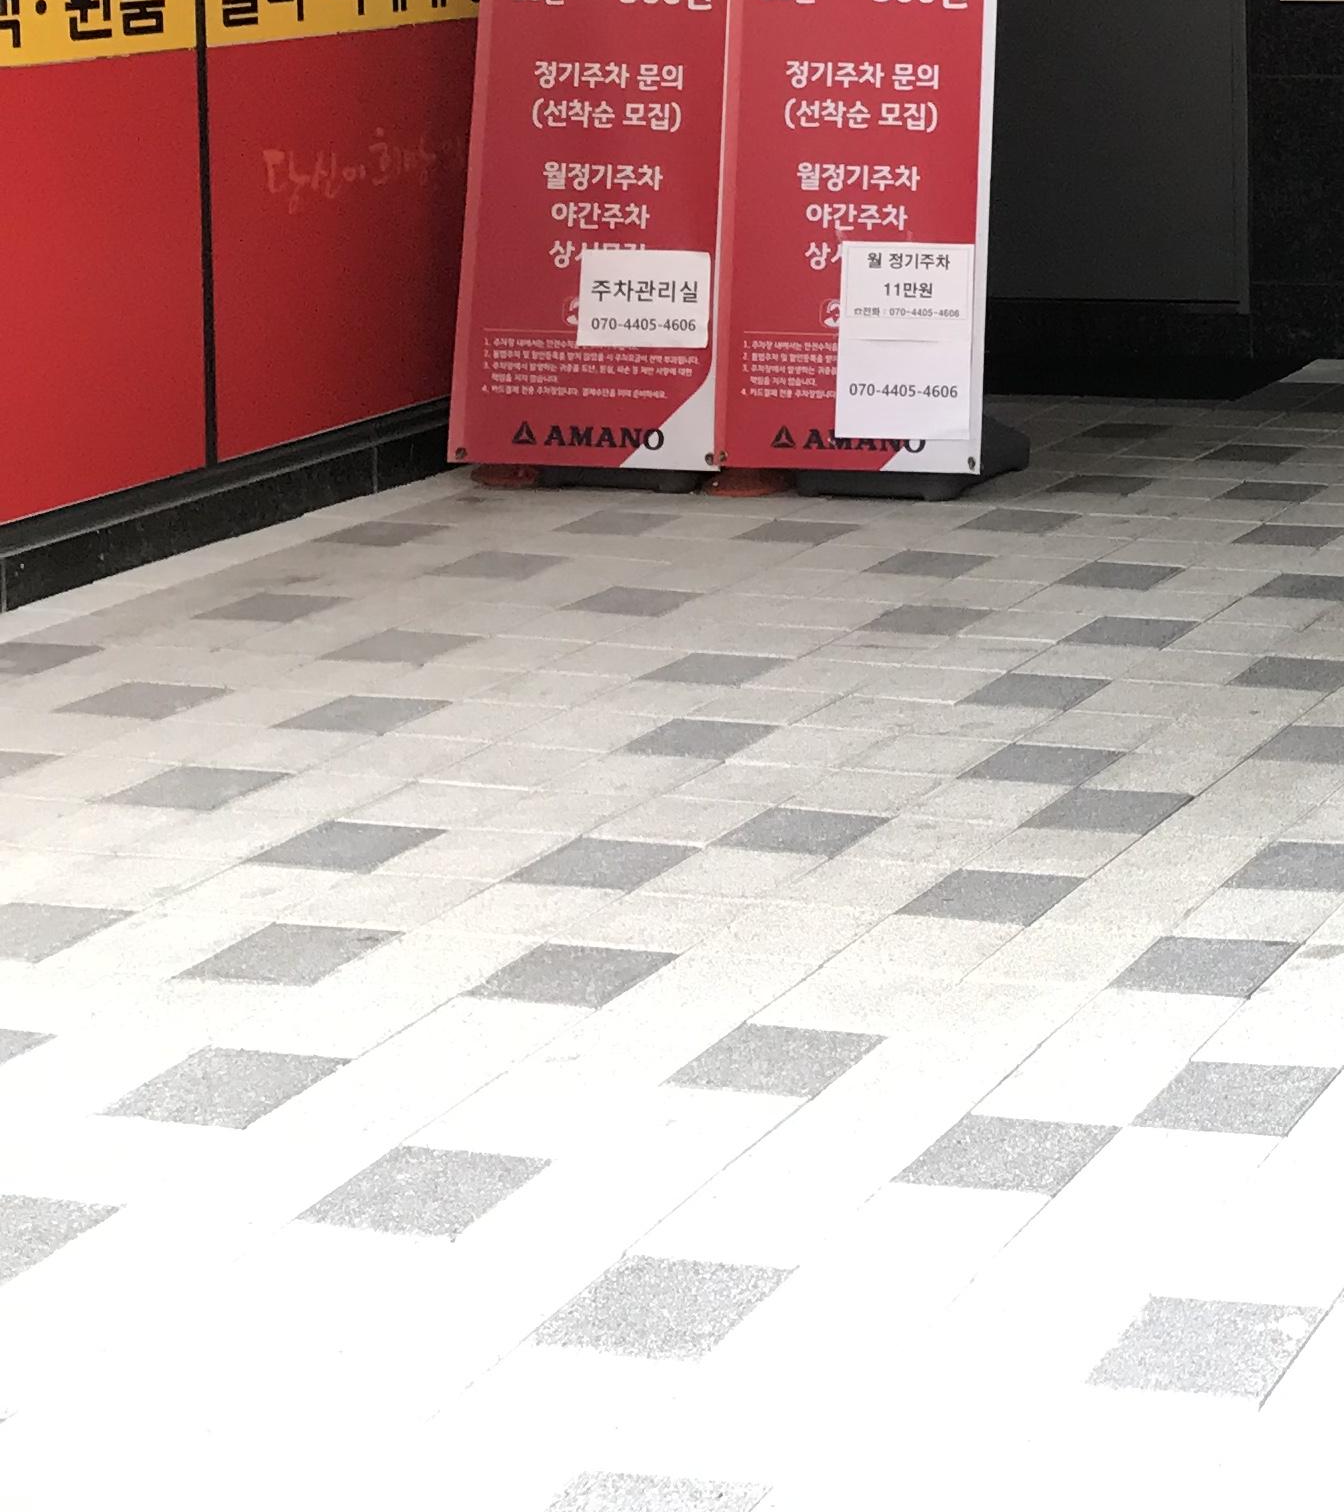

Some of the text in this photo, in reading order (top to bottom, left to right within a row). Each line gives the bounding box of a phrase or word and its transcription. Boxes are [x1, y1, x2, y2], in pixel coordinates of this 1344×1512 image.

[534, 62, 684, 90] 정기주차 문의
[785, 61, 940, 90] 정기주차 문의
[531, 99, 682, 133] (선착순 모집)
[784, 99, 939, 133] (선착순 모집)
[543, 162, 664, 191] 월정기주차
[796, 162, 921, 192] 월정기주차
[551, 202, 650, 231] 야간주차
[805, 203, 908, 232] 야간주차
[867, 252, 951, 270] 월 정기주차
[591, 280, 698, 303] 주차관리실
[883, 282, 933, 299] 11만원
[591, 317, 697, 332] 070-4405-4606
[849, 383, 958, 398] 070-4405-4606
[544, 425, 665, 451] AMANO
